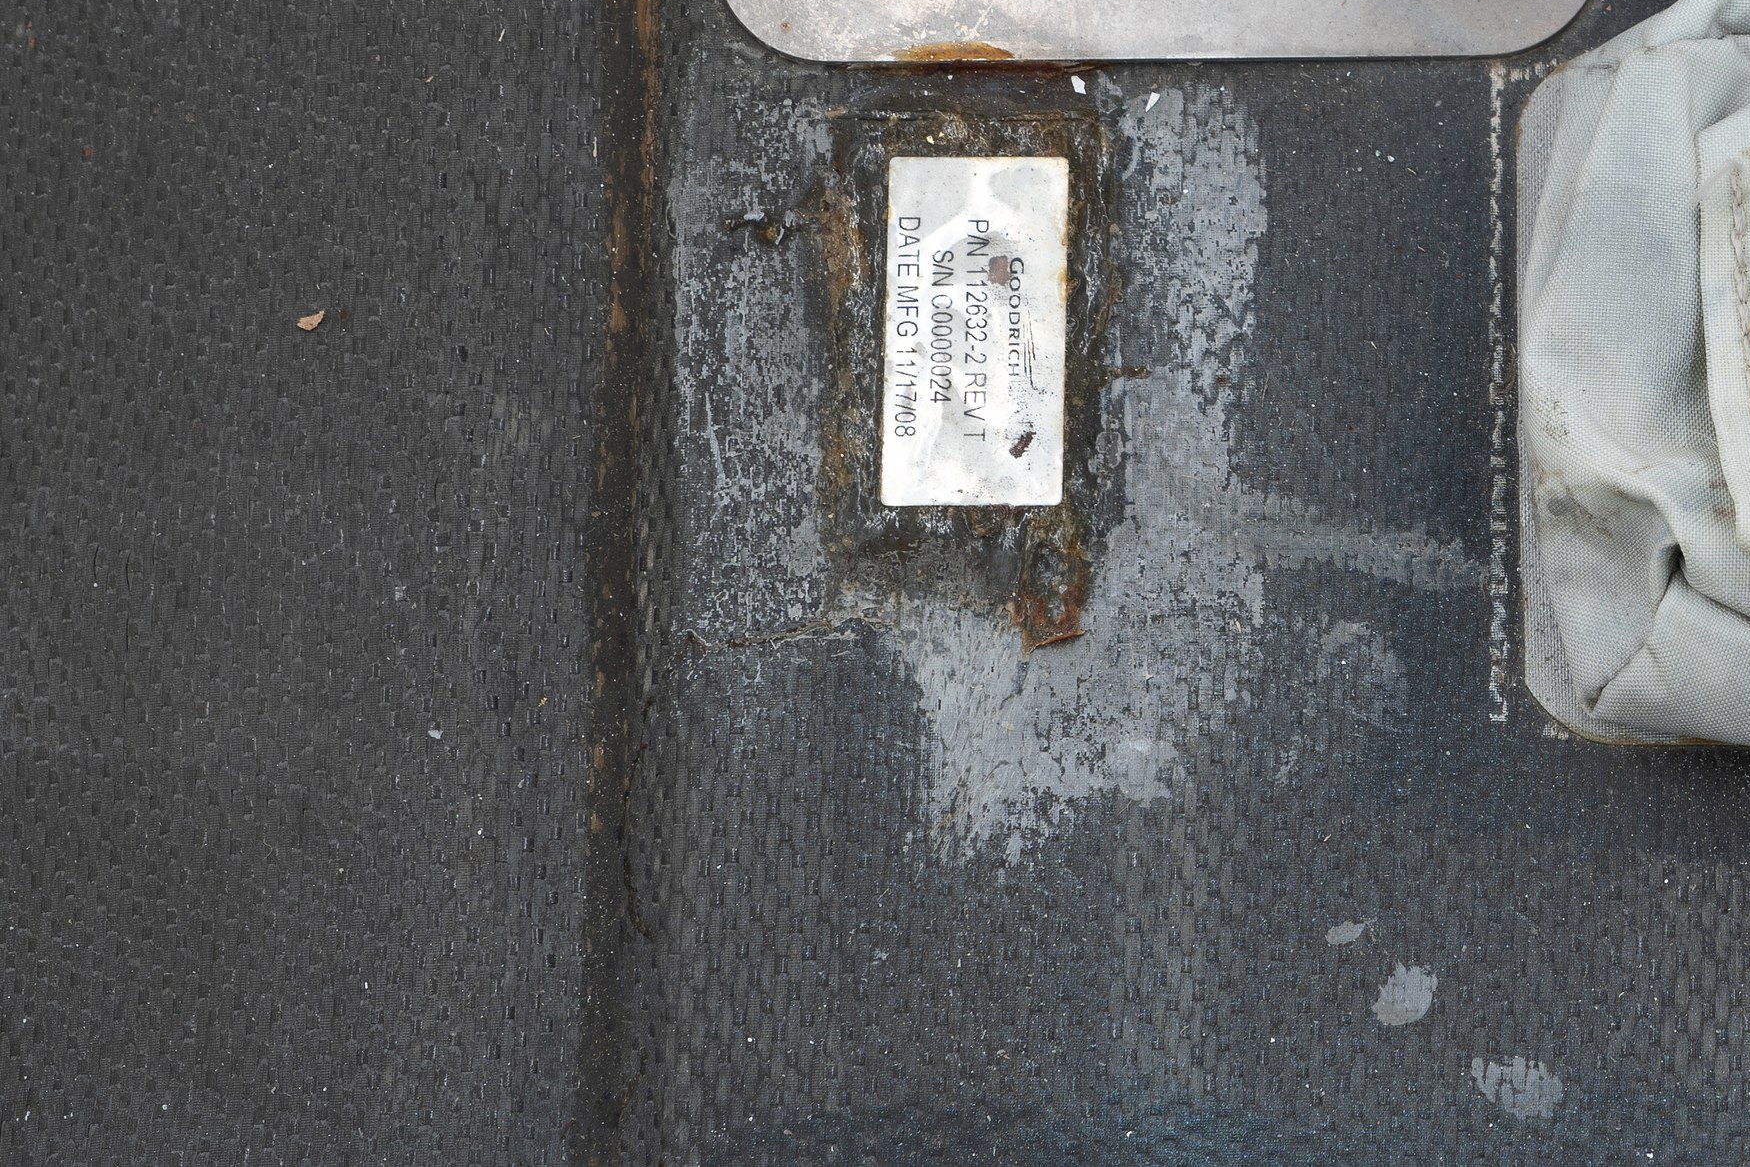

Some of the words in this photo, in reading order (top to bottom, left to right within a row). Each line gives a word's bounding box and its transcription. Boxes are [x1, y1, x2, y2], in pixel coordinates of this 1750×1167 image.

[897, 216, 921, 278] DATE
[966, 219, 990, 257] P/N
[931, 249, 954, 288] S/N
[896, 284, 919, 338] MFG
[964, 265, 988, 365] 112632-2
[929, 293, 953, 404] C0000024
[894, 346, 917, 438] 11/17/08
[963, 372, 986, 421] REV
[963, 427, 986, 443] T
